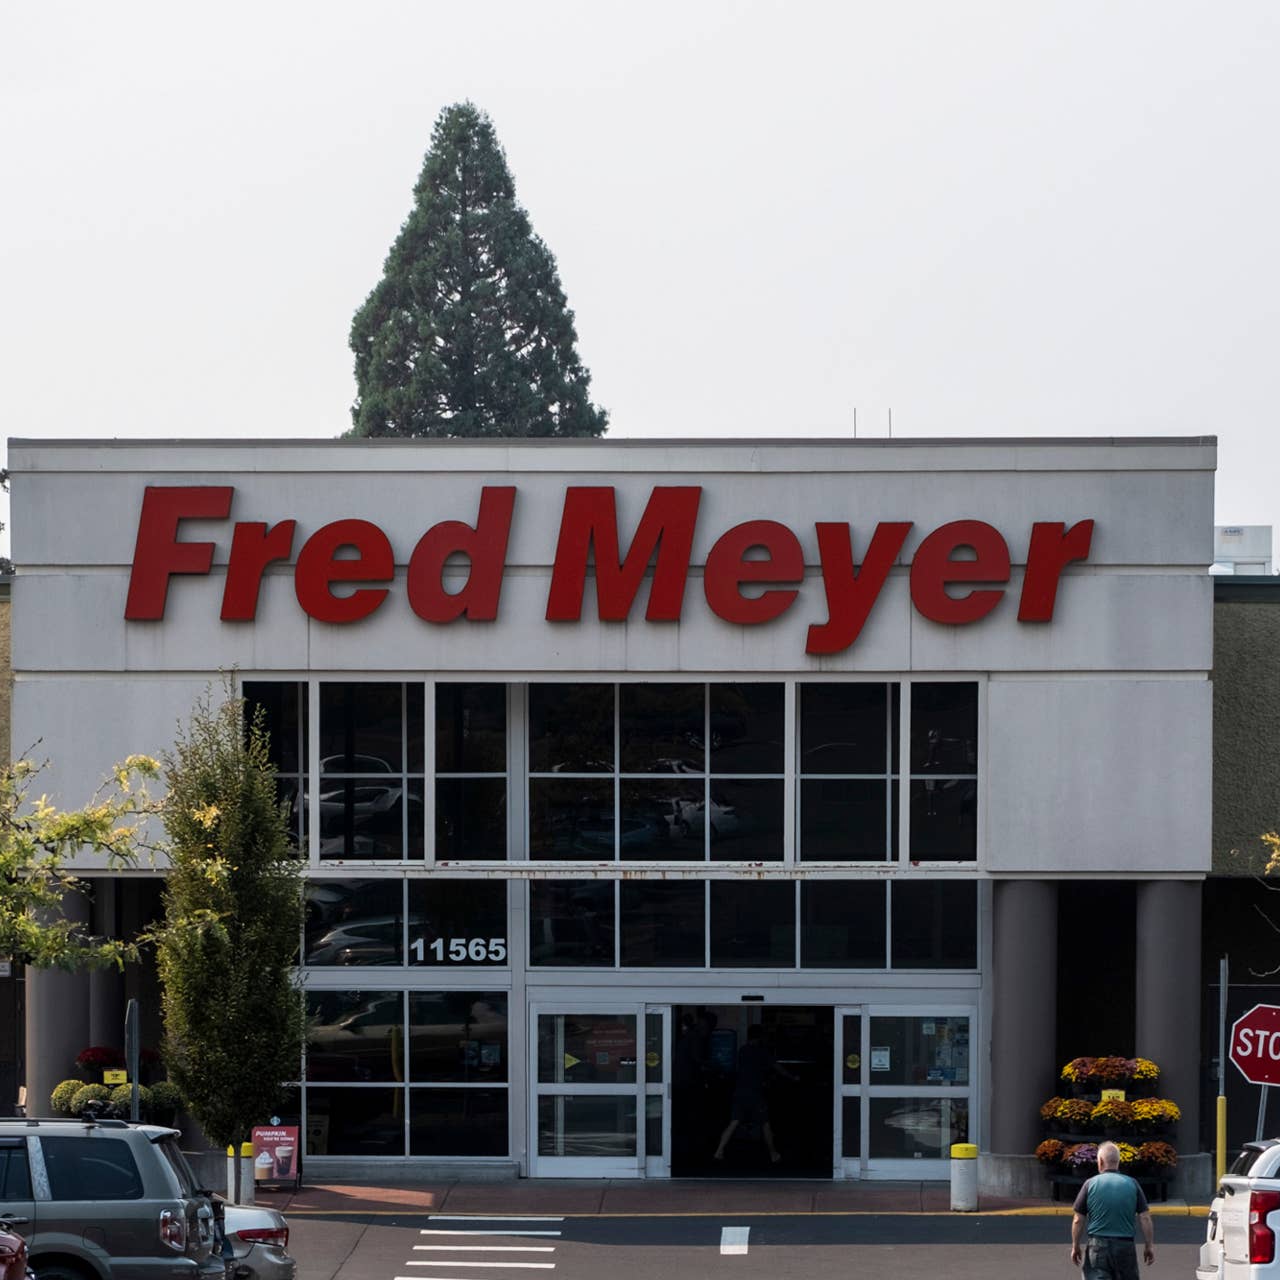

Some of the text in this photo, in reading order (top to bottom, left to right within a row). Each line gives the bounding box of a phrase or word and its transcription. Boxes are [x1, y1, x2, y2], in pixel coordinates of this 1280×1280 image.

[124, 485, 1095, 655] Fred Meyer
[410, 937, 507, 961] 11565
